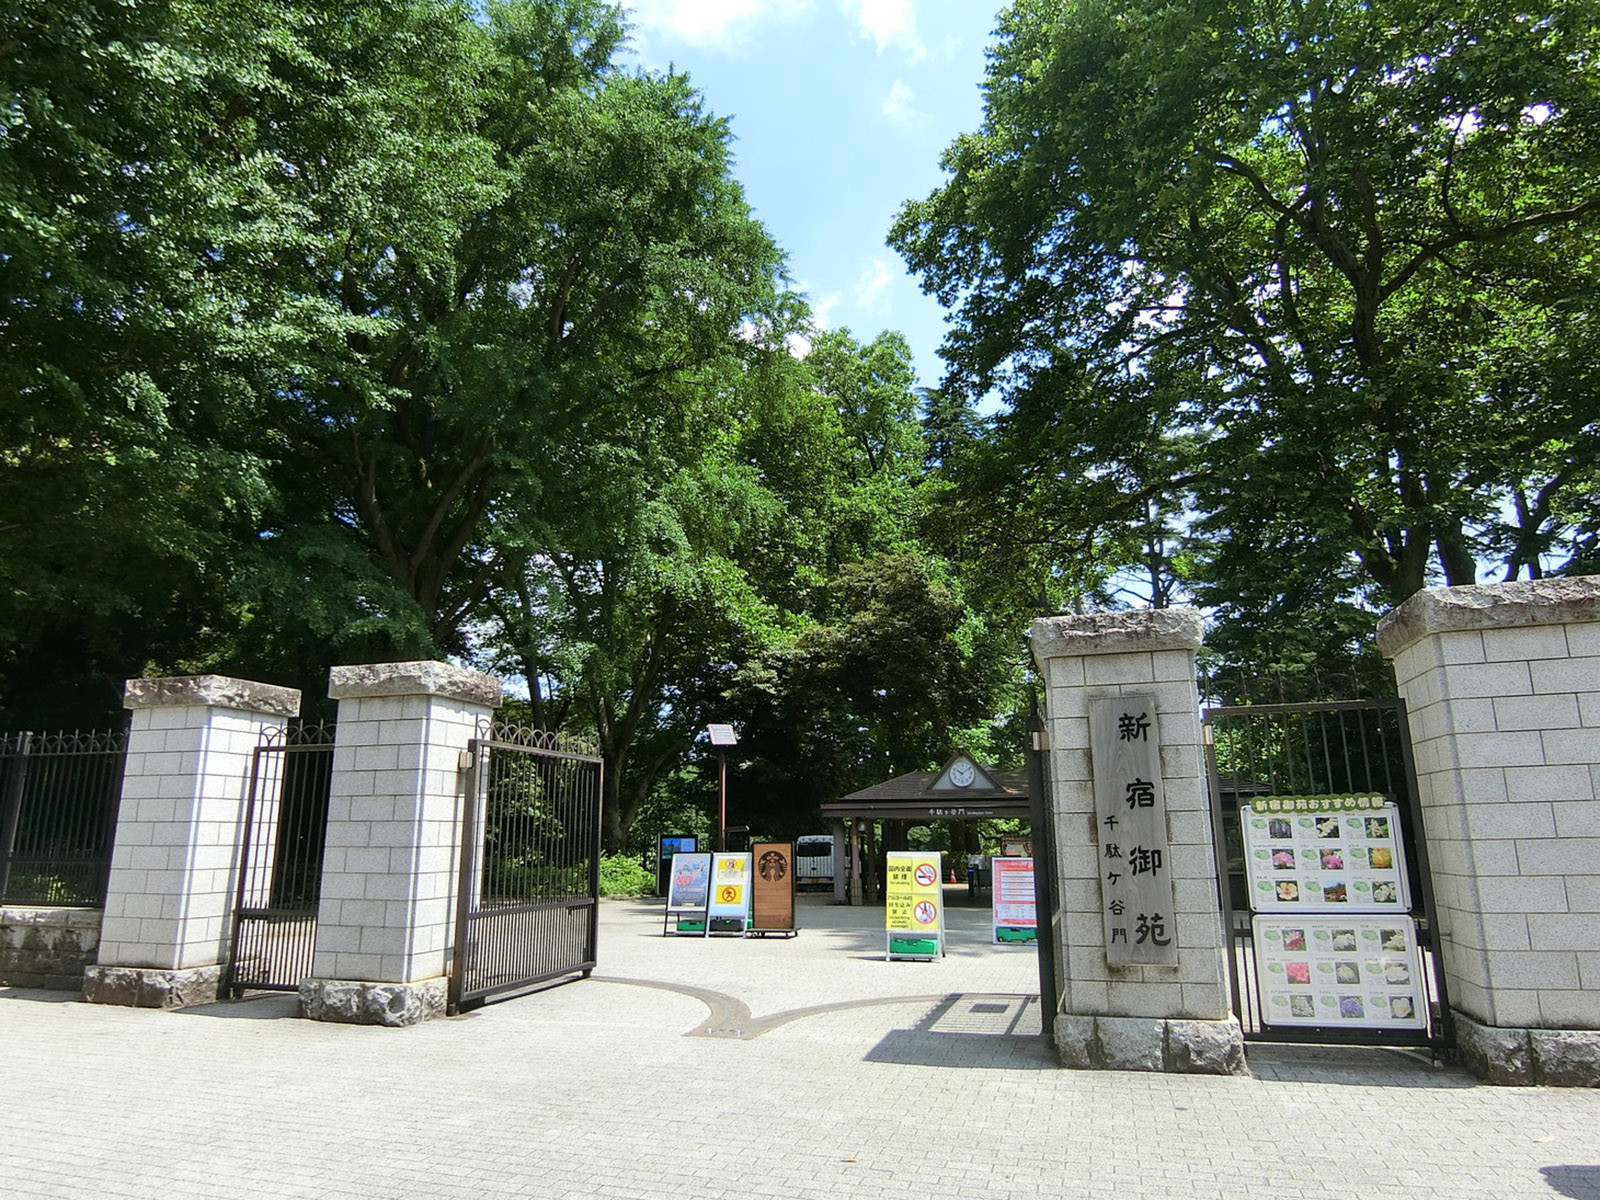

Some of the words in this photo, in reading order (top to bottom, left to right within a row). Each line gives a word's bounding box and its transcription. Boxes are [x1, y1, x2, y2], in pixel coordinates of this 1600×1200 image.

[1118, 712, 1171, 946] 新宿御苑
[1256, 797, 1385, 811] 新宿御苑おすすめ情報
